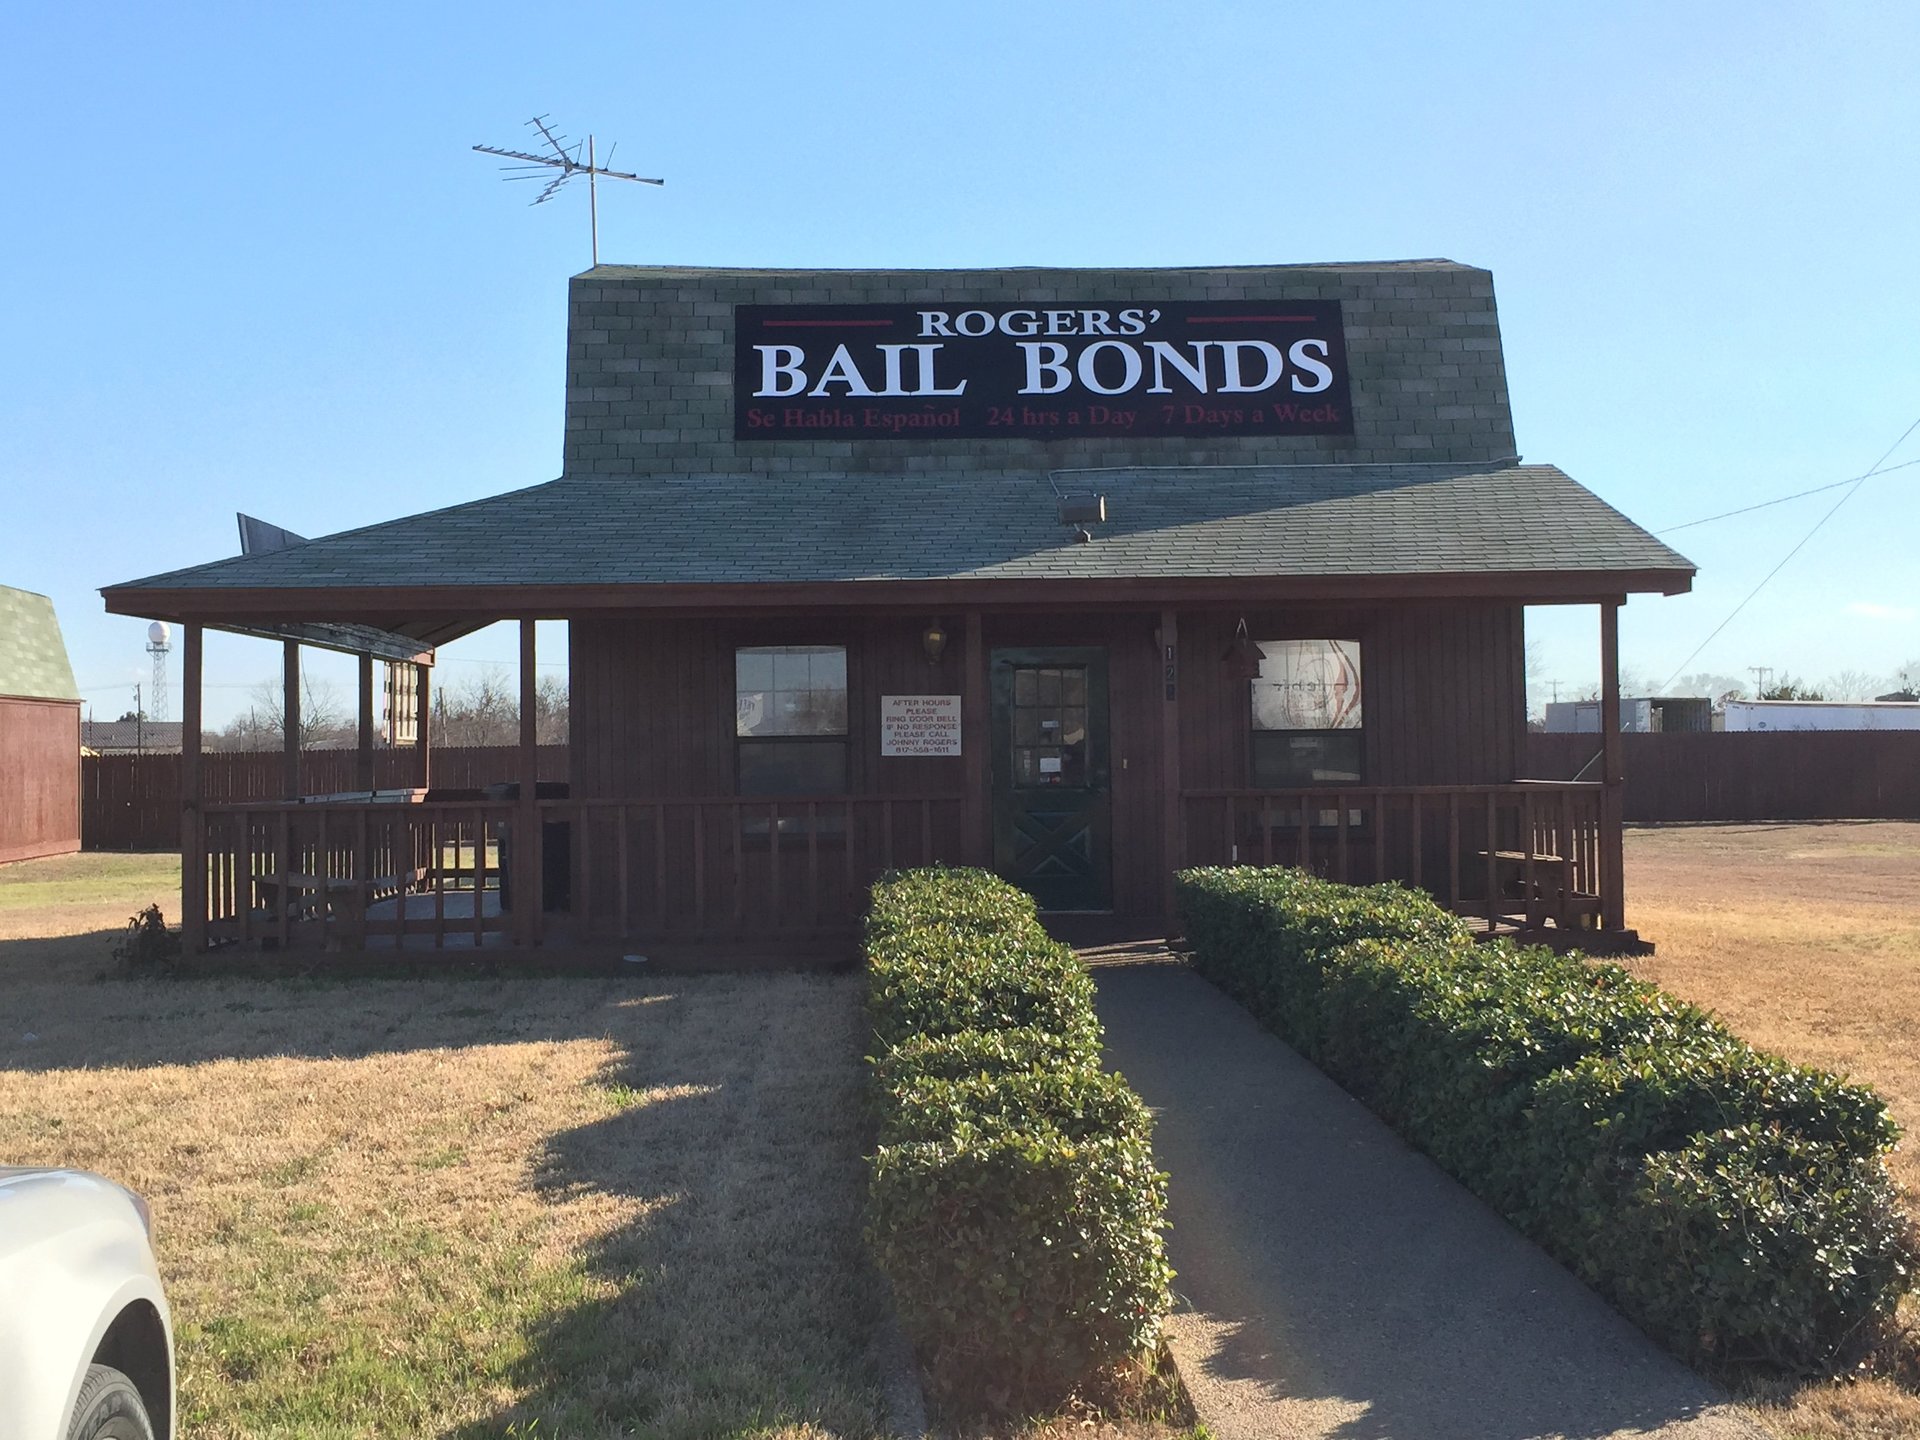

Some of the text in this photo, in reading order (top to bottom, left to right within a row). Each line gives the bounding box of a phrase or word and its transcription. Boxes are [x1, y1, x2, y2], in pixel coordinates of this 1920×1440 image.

[752, 338, 1334, 398] BAIL BONDS
[747, 403, 1340, 433] Se Habla Español 24 hrs a Day 7 Days a Week
